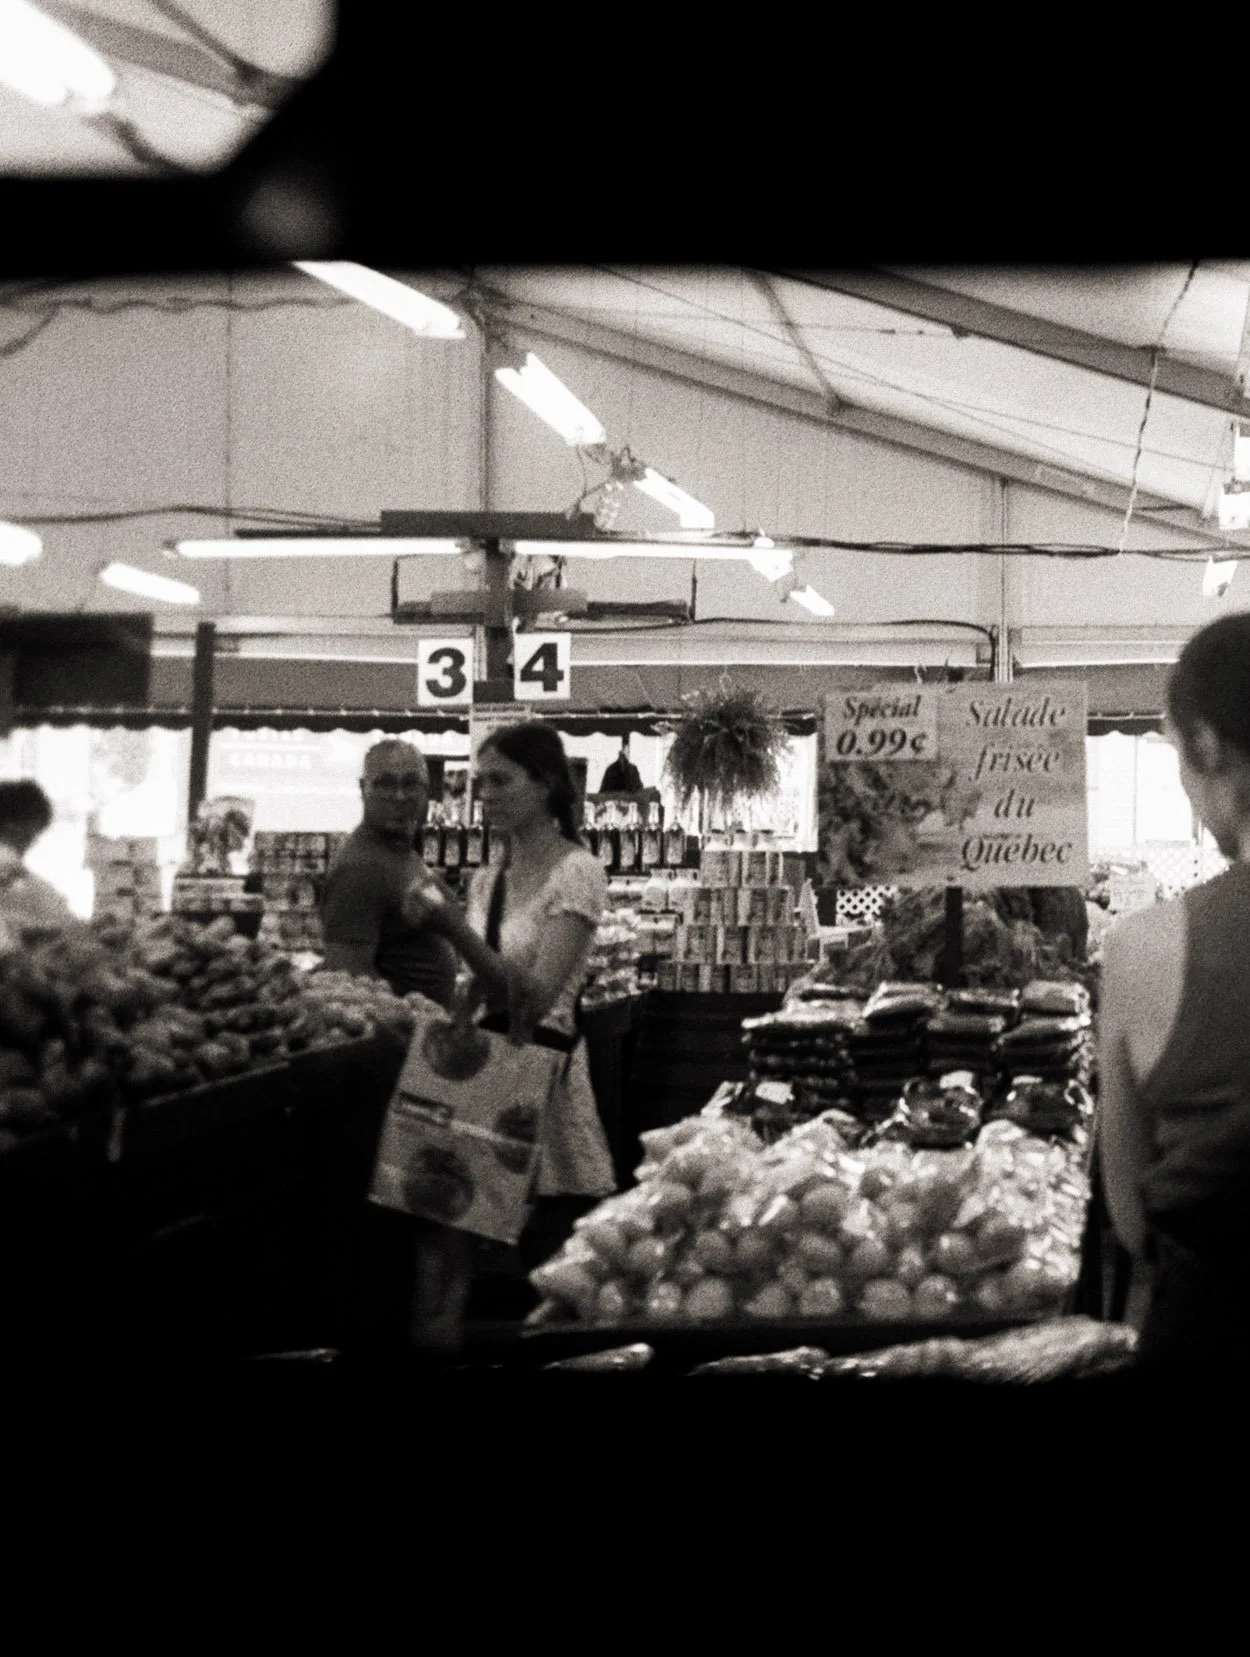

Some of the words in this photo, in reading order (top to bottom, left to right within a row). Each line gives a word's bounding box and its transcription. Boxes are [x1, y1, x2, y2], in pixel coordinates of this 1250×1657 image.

[426, 647, 467, 698] 3
[520, 642, 564, 692] 4
[965, 697, 1066, 728] Salade
[993, 788, 1035, 818] du
